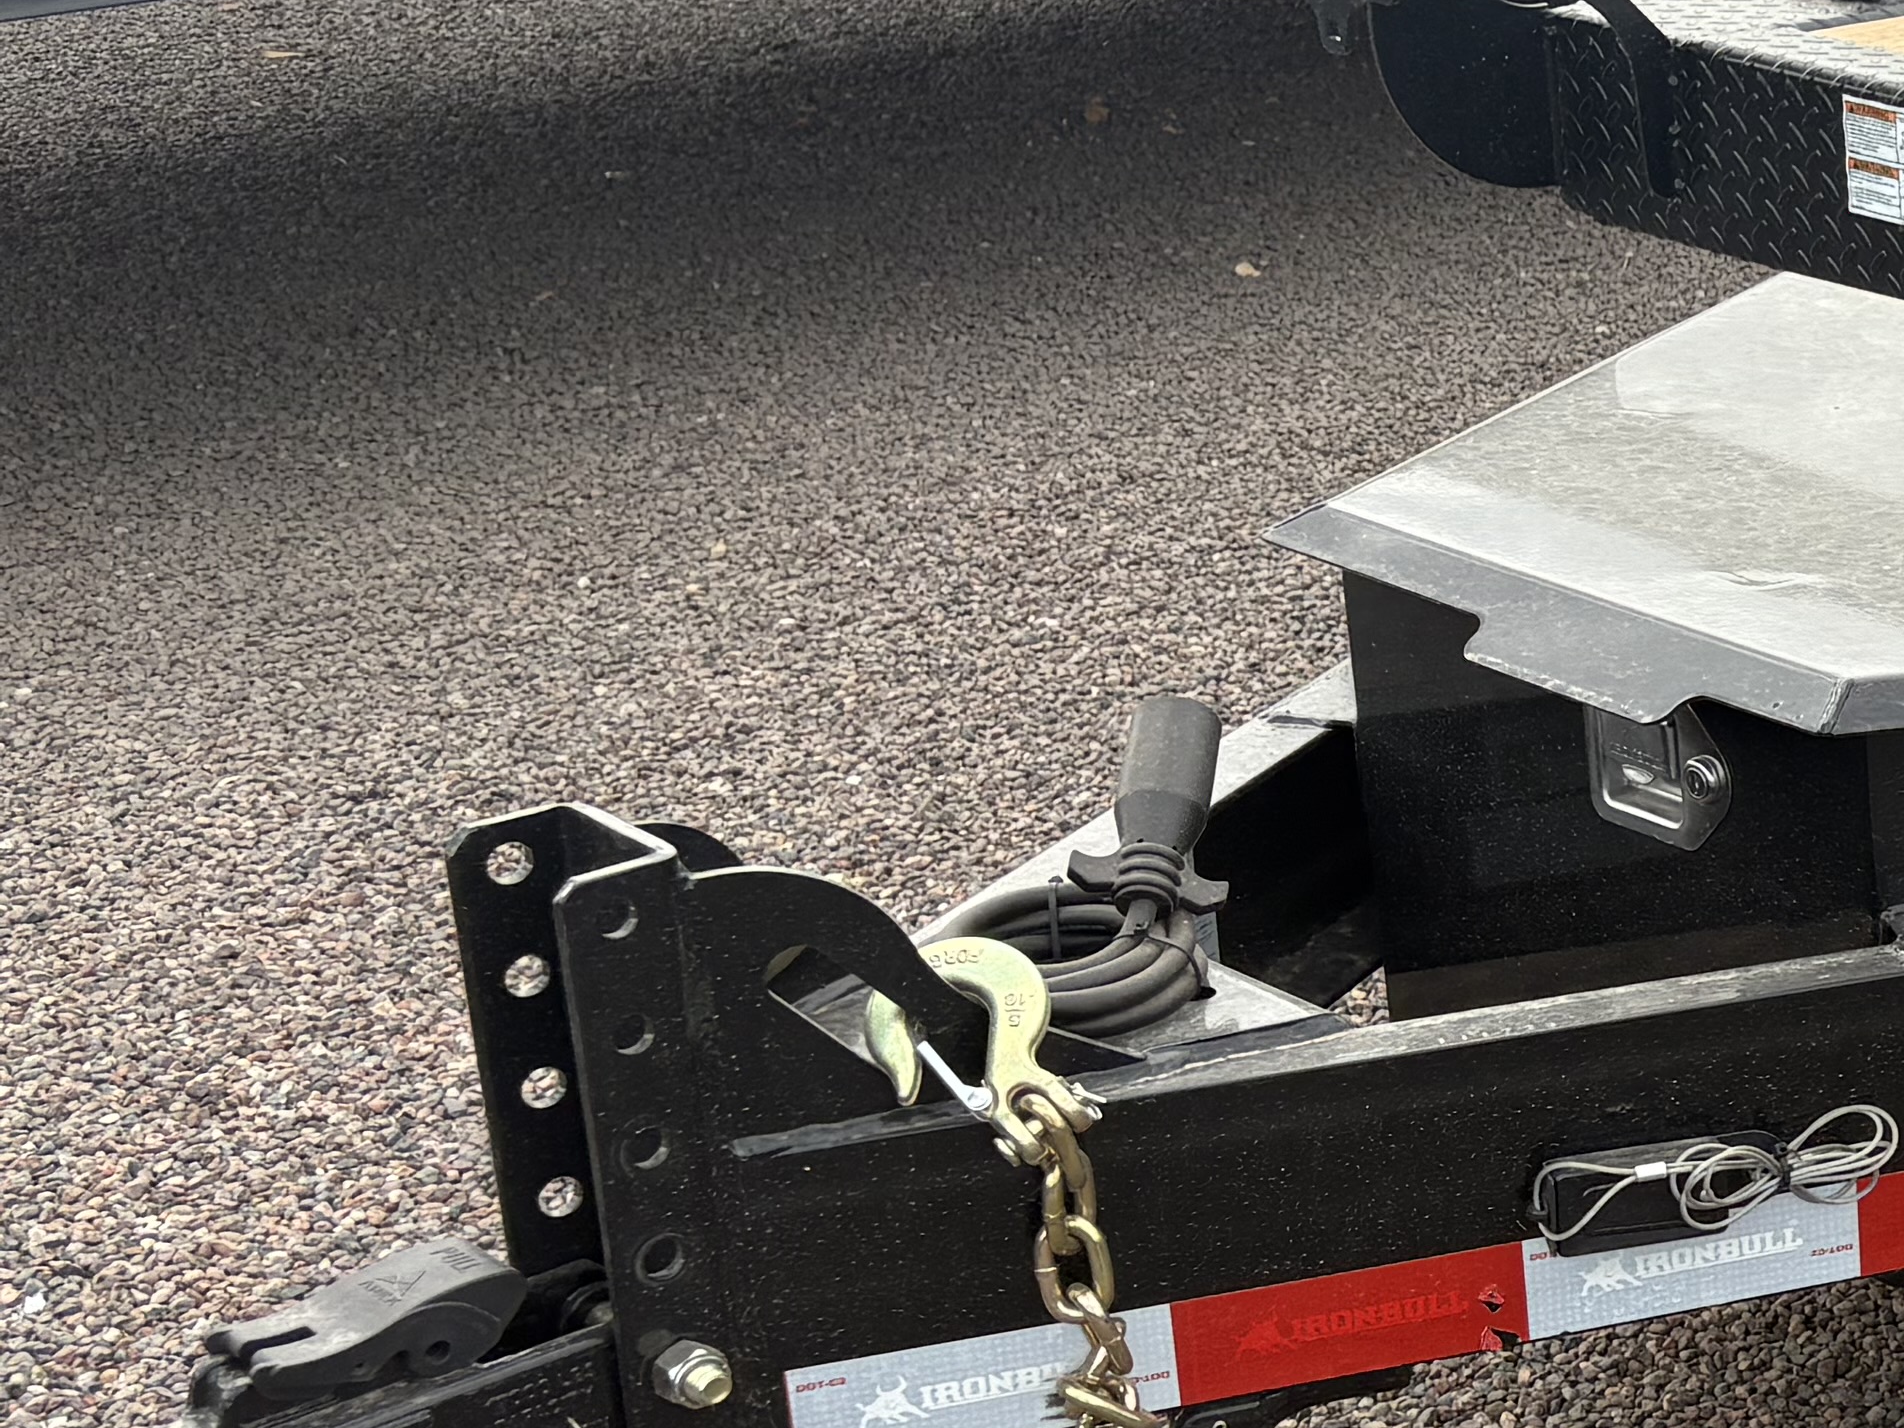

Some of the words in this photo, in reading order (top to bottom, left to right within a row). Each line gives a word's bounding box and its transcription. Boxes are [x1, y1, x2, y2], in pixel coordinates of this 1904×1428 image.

[1634, 1226, 1804, 1277] IRONBULL
[1292, 1289, 1470, 1341] IRONBULL
[919, 1360, 1069, 1410] IRONBU
